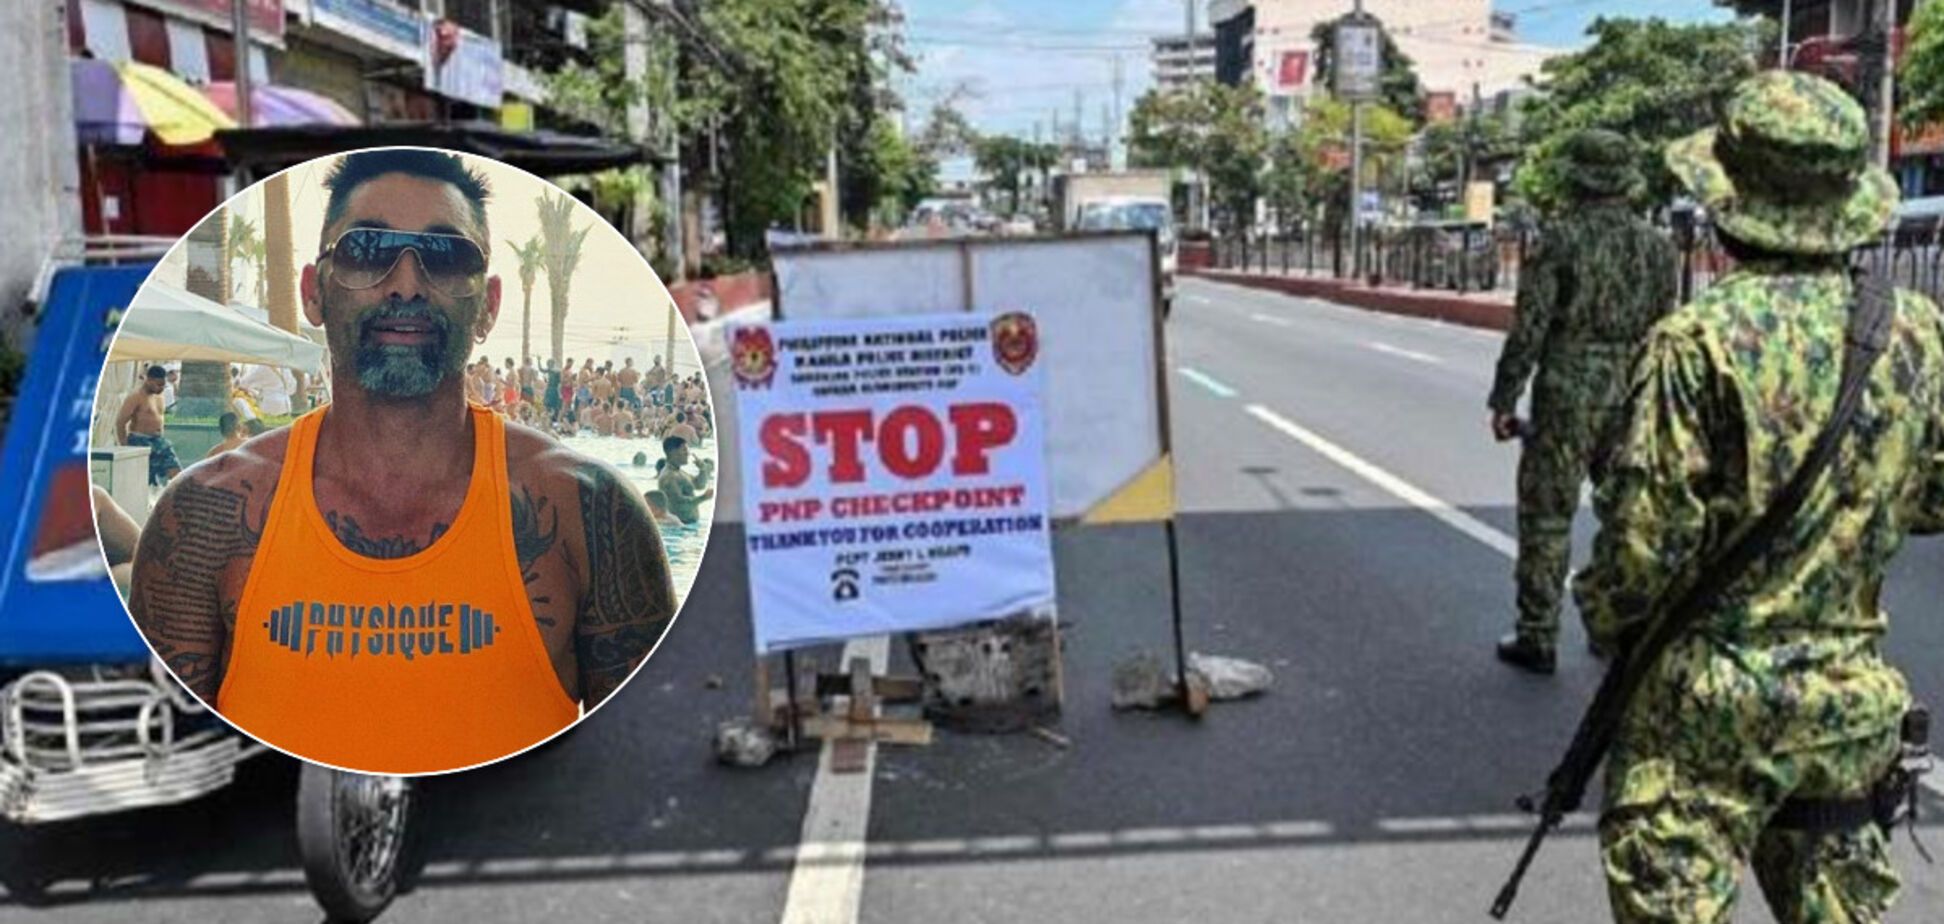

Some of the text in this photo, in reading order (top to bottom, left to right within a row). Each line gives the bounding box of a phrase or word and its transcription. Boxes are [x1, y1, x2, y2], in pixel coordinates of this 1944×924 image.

[864, 331, 934, 346] NATIONAL
[940, 327, 987, 341] POLICE
[795, 346, 973, 367] MANILA POLICE DISTRICT
[759, 402, 1017, 489] STOP
[759, 486, 1025, 523] PNP CHECKPOINT
[749, 514, 1043, 551] THANK YOU FOR COOPERATION
[305, 600, 454, 660] PHYSIQUE
